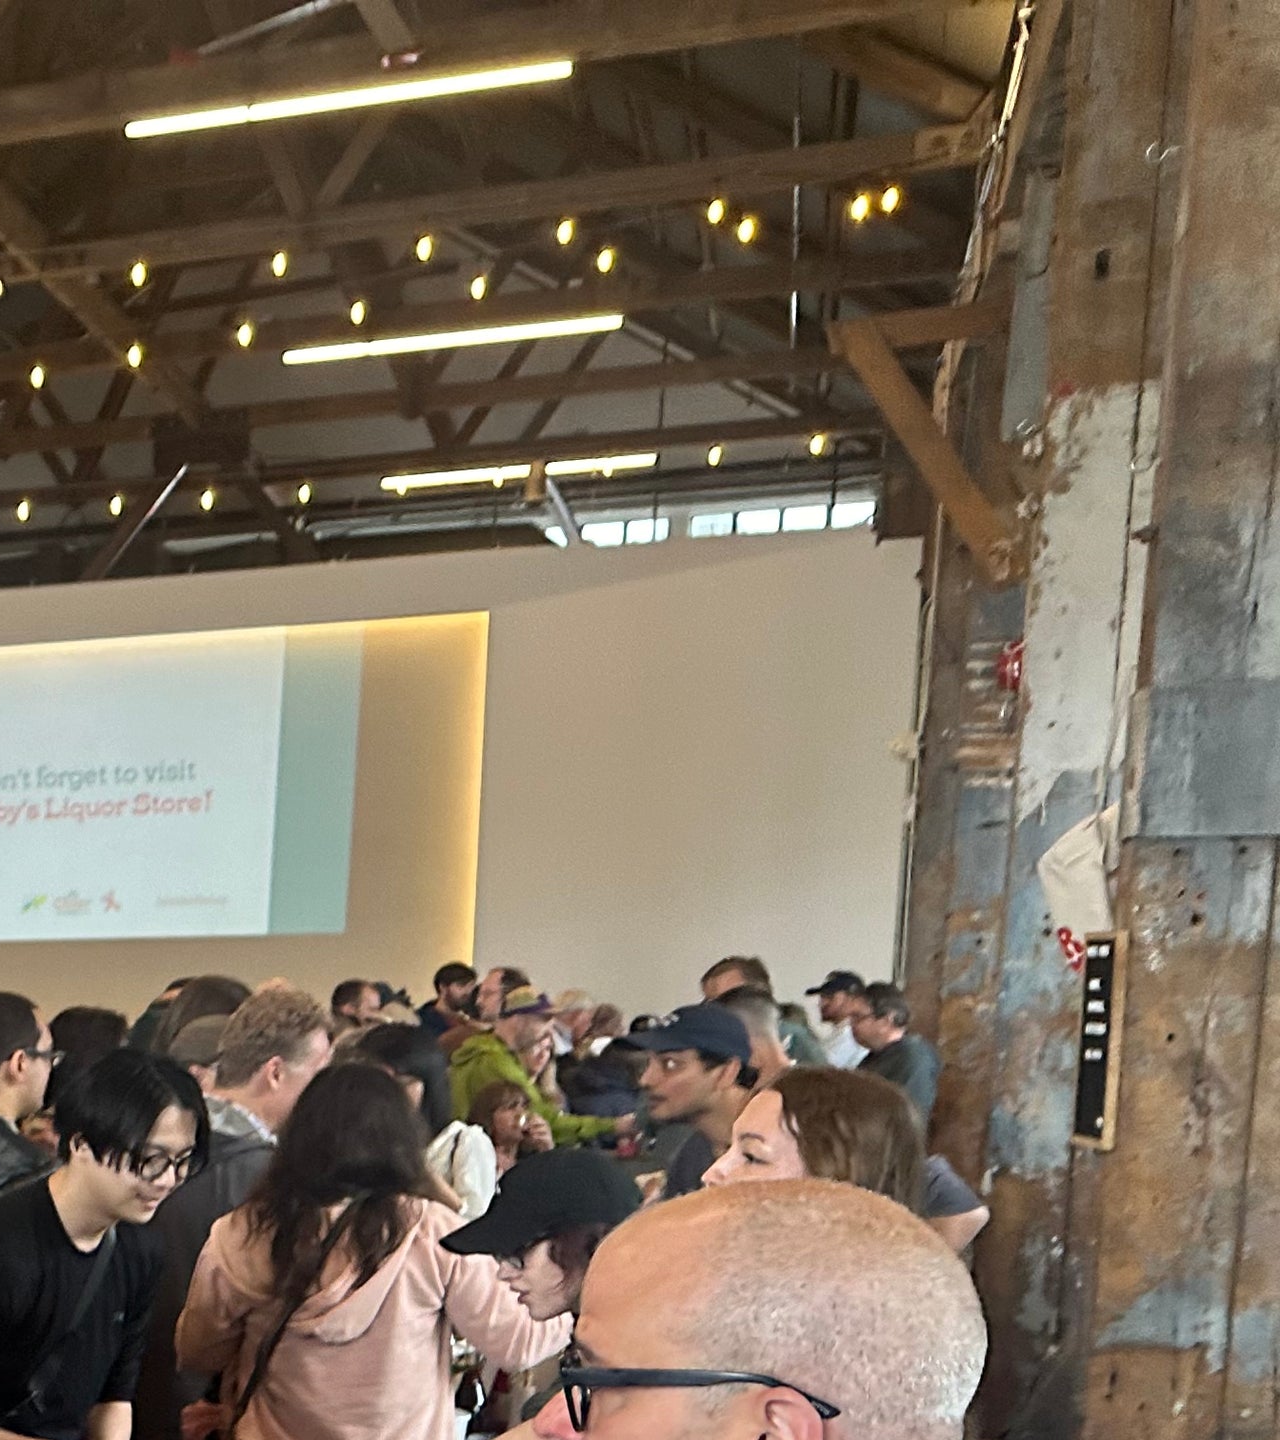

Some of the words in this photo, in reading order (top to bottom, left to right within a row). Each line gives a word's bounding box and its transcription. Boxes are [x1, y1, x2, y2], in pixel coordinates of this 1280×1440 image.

[37, 764, 107, 792] forget
[114, 764, 138, 785] to
[143, 759, 196, 784] visit
[43, 796, 127, 823] Liquor
[132, 788, 213, 816] Store!
